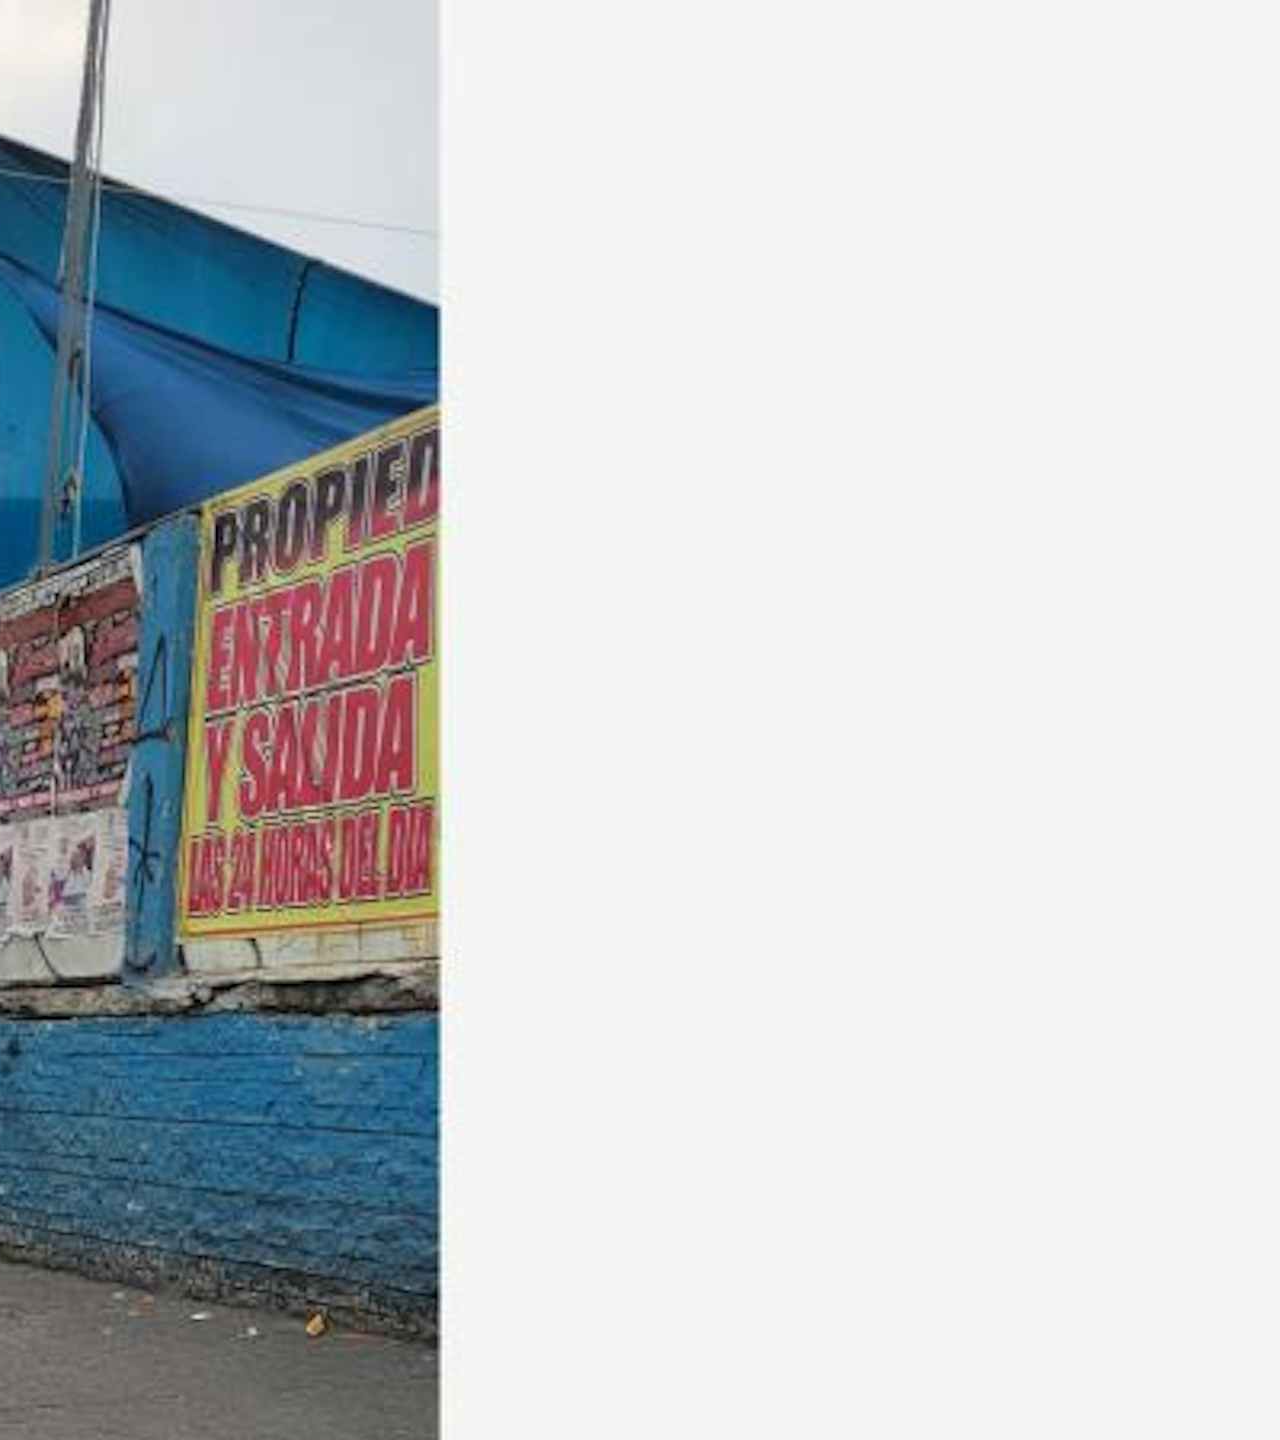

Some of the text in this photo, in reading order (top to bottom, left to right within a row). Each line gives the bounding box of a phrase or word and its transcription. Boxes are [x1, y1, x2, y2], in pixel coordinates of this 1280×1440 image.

[206, 542, 433, 712] ENTRADA
[206, 723, 235, 827] Y
[239, 674, 417, 819] SALIDA
[187, 834, 224, 917] LAS
[226, 829, 256, 914] 24
[256, 819, 333, 911] HORAS
[337, 808, 386, 905] DEL
[387, 803, 432, 898] DIA
